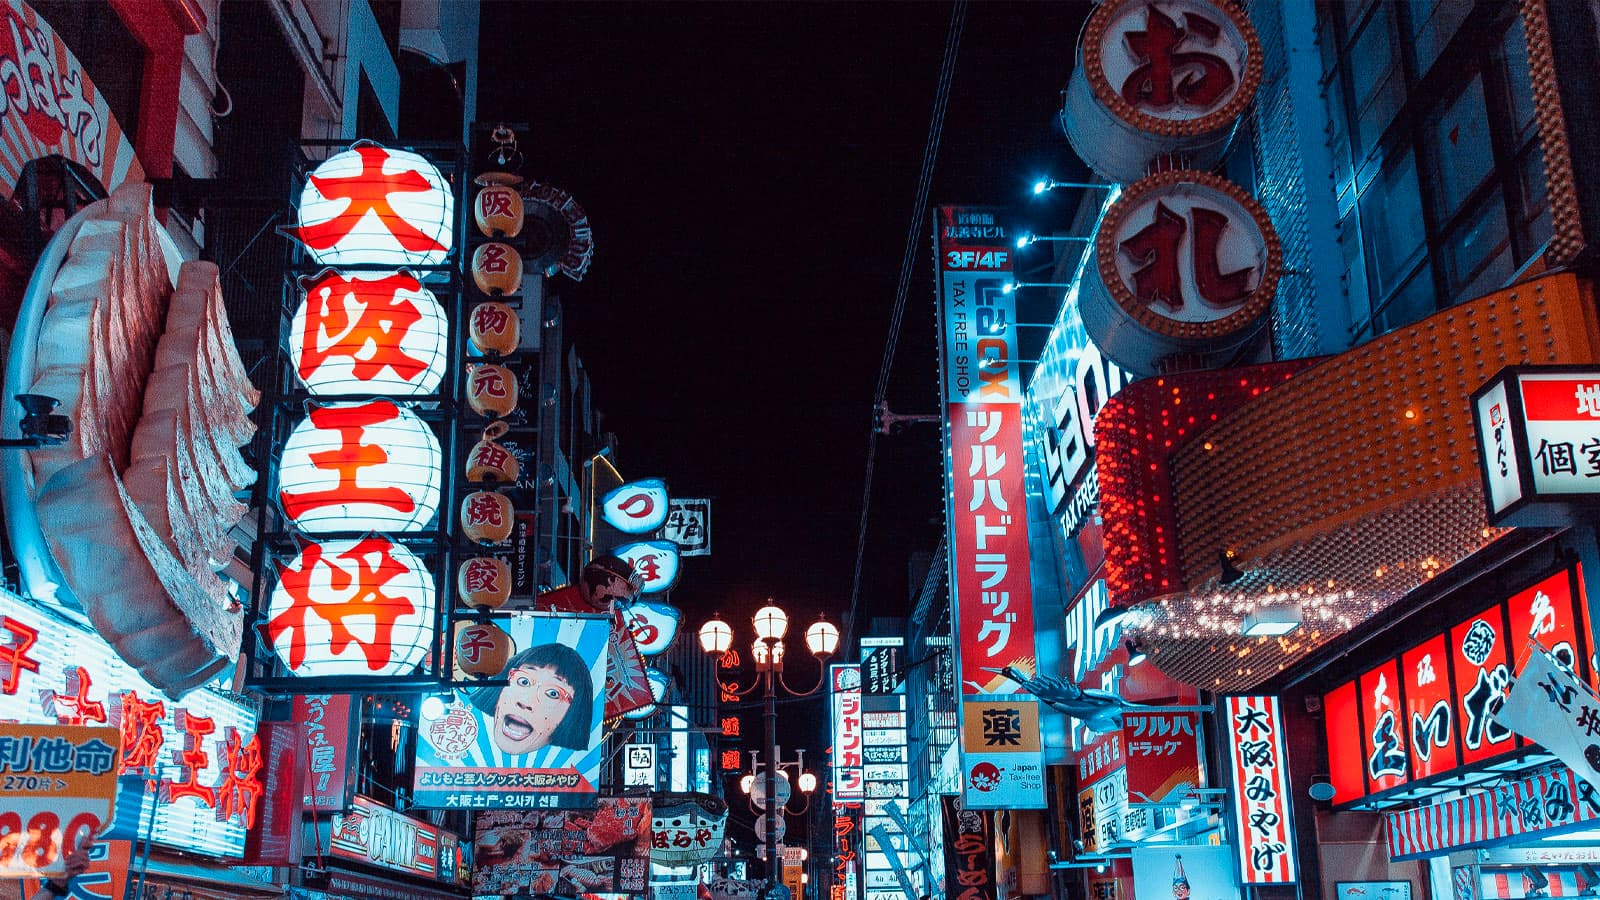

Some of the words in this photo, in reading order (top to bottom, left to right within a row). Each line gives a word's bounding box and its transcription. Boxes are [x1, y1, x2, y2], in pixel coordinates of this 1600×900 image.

[947, 251, 1008, 269] 3F/4F
[953, 280, 965, 307] TAX
[954, 313, 968, 350] FREE
[956, 357, 971, 397] SHOP
[256, 140, 448, 671] 大阪王将
[966, 410, 1016, 657] ツルハドラッグ
[1060, 509, 1078, 540] TAX
[842, 696, 860, 789] ジャンカラ
[982, 708, 1021, 746] 薬
[1126, 716, 1193, 736] ツルハ
[1127, 741, 1182, 757] ドラッグ
[1021, 782, 1042, 791] Shop
[1236, 707, 1285, 872] 大阪みやげ
